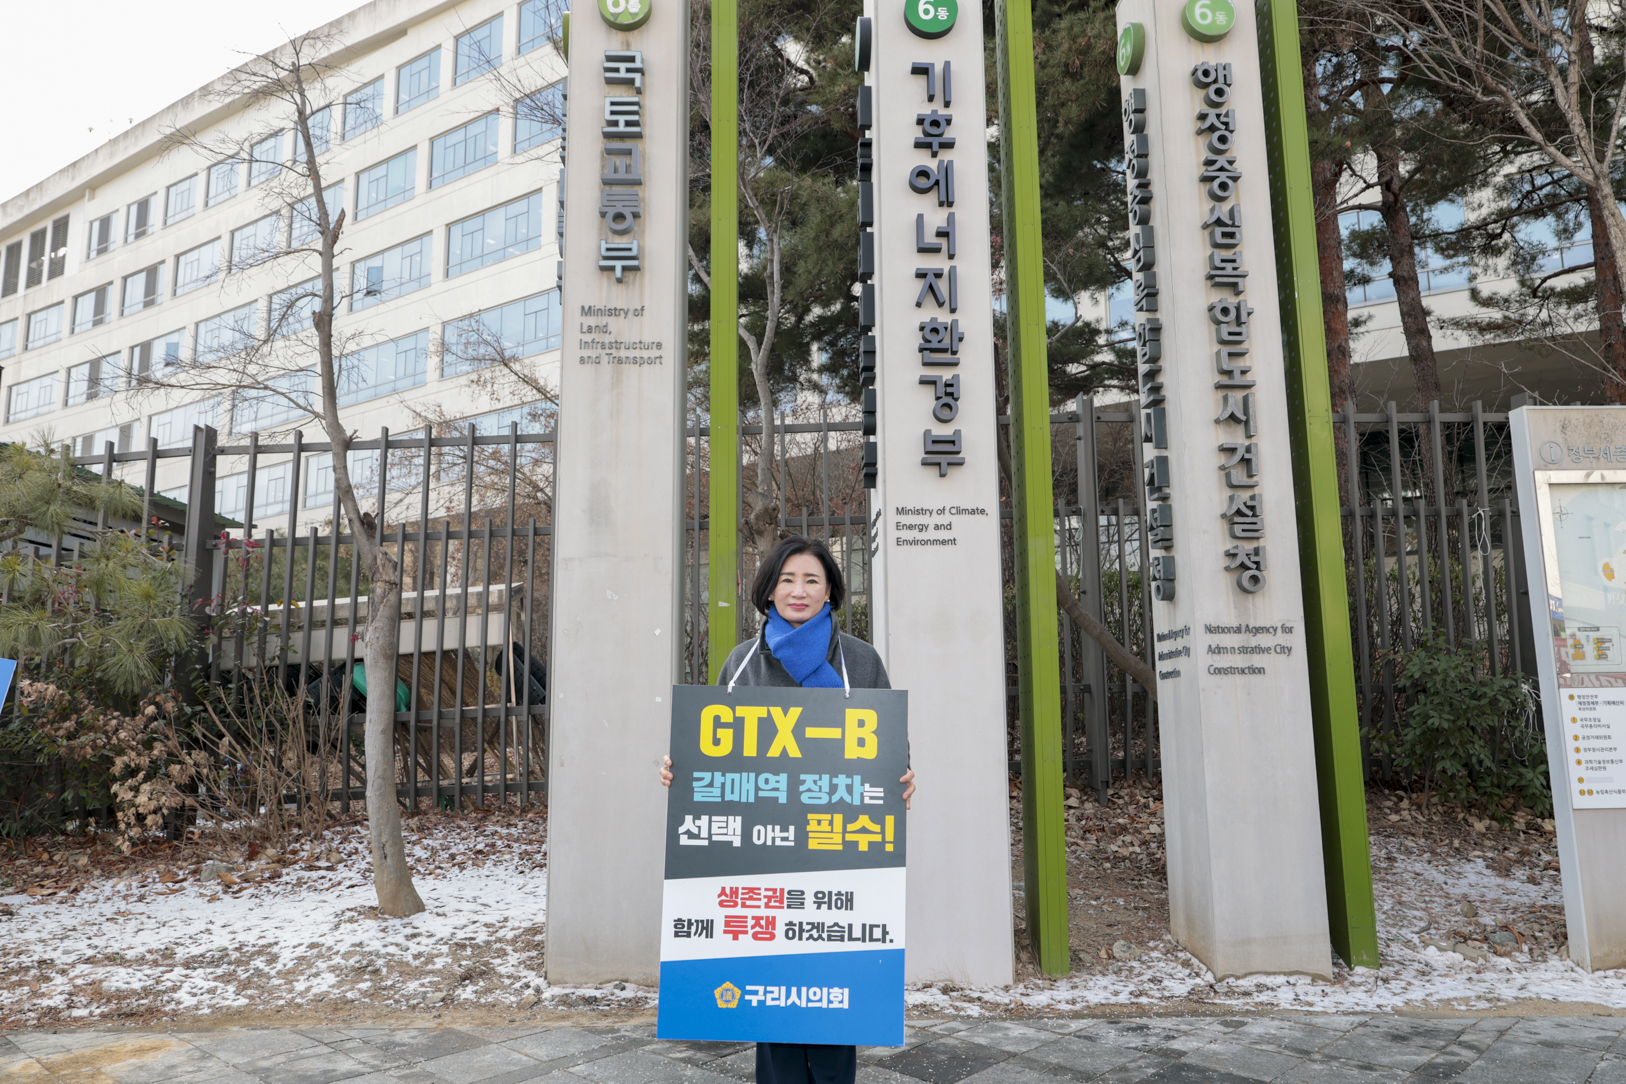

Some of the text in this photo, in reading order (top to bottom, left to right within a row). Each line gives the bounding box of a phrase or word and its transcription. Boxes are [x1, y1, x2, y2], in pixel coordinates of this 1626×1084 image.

[918, 0, 949, 20] 6동
[1194, 0, 1228, 25] 6동
[598, 50, 645, 283] 국토교통부
[908, 60, 966, 478] 기후에너지환경부
[580, 305, 645, 319] Ministry of
[580, 322, 612, 335] Land,
[1191, 61, 1268, 593] 행정중심복합도시건설청
[579, 338, 663, 350] Infrastructure
[579, 352, 663, 367] and Transport
[896, 506, 989, 517] Ministry of Climate,
[896, 521, 952, 532] Energy and
[896, 537, 957, 546] Environment
[1204, 623, 1294, 637] National Agency for
[1274, 643, 1293, 657] City
[1207, 664, 1266, 676] Construction
[692, 771, 884, 805] 갈매역 정차는
[678, 813, 895, 852] 선택 아닌 필수!
[717, 886, 854, 911] 생존권을 위해
[673, 915, 894, 944] 함께 투쟁 하겠습니다.
[744, 985, 849, 1009] 구리시의회
